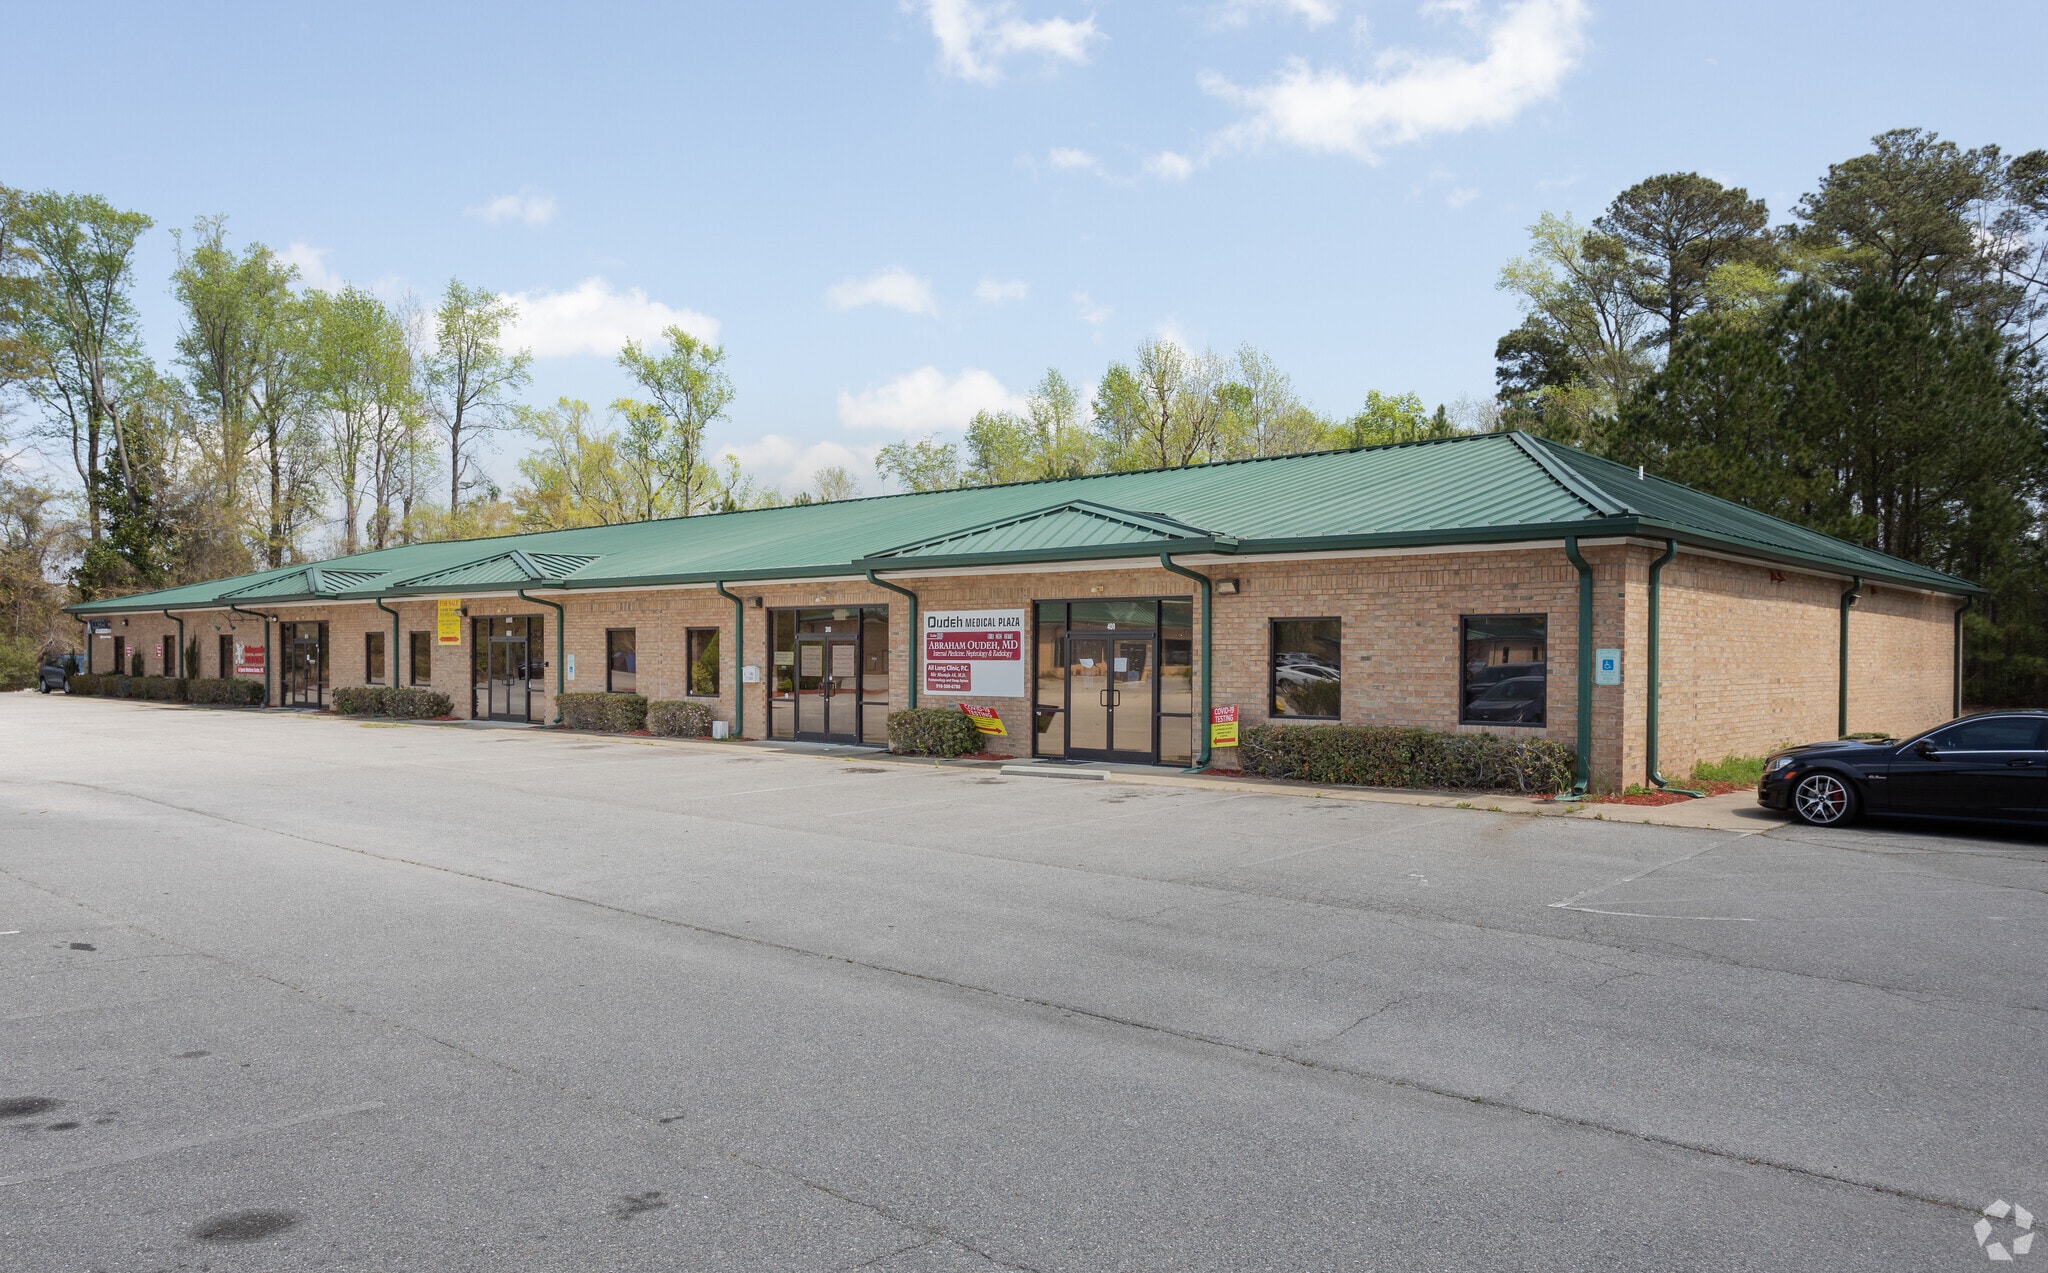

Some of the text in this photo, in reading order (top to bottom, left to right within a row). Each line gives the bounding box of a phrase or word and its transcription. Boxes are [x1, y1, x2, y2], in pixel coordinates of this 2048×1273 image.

[927, 616, 1020, 628] Oudeh MEDICAL PLAZA
[1002, 640, 1018, 650] MD
[1214, 706, 1235, 715] COVID-19
[1215, 714, 1234, 723] TESTING
